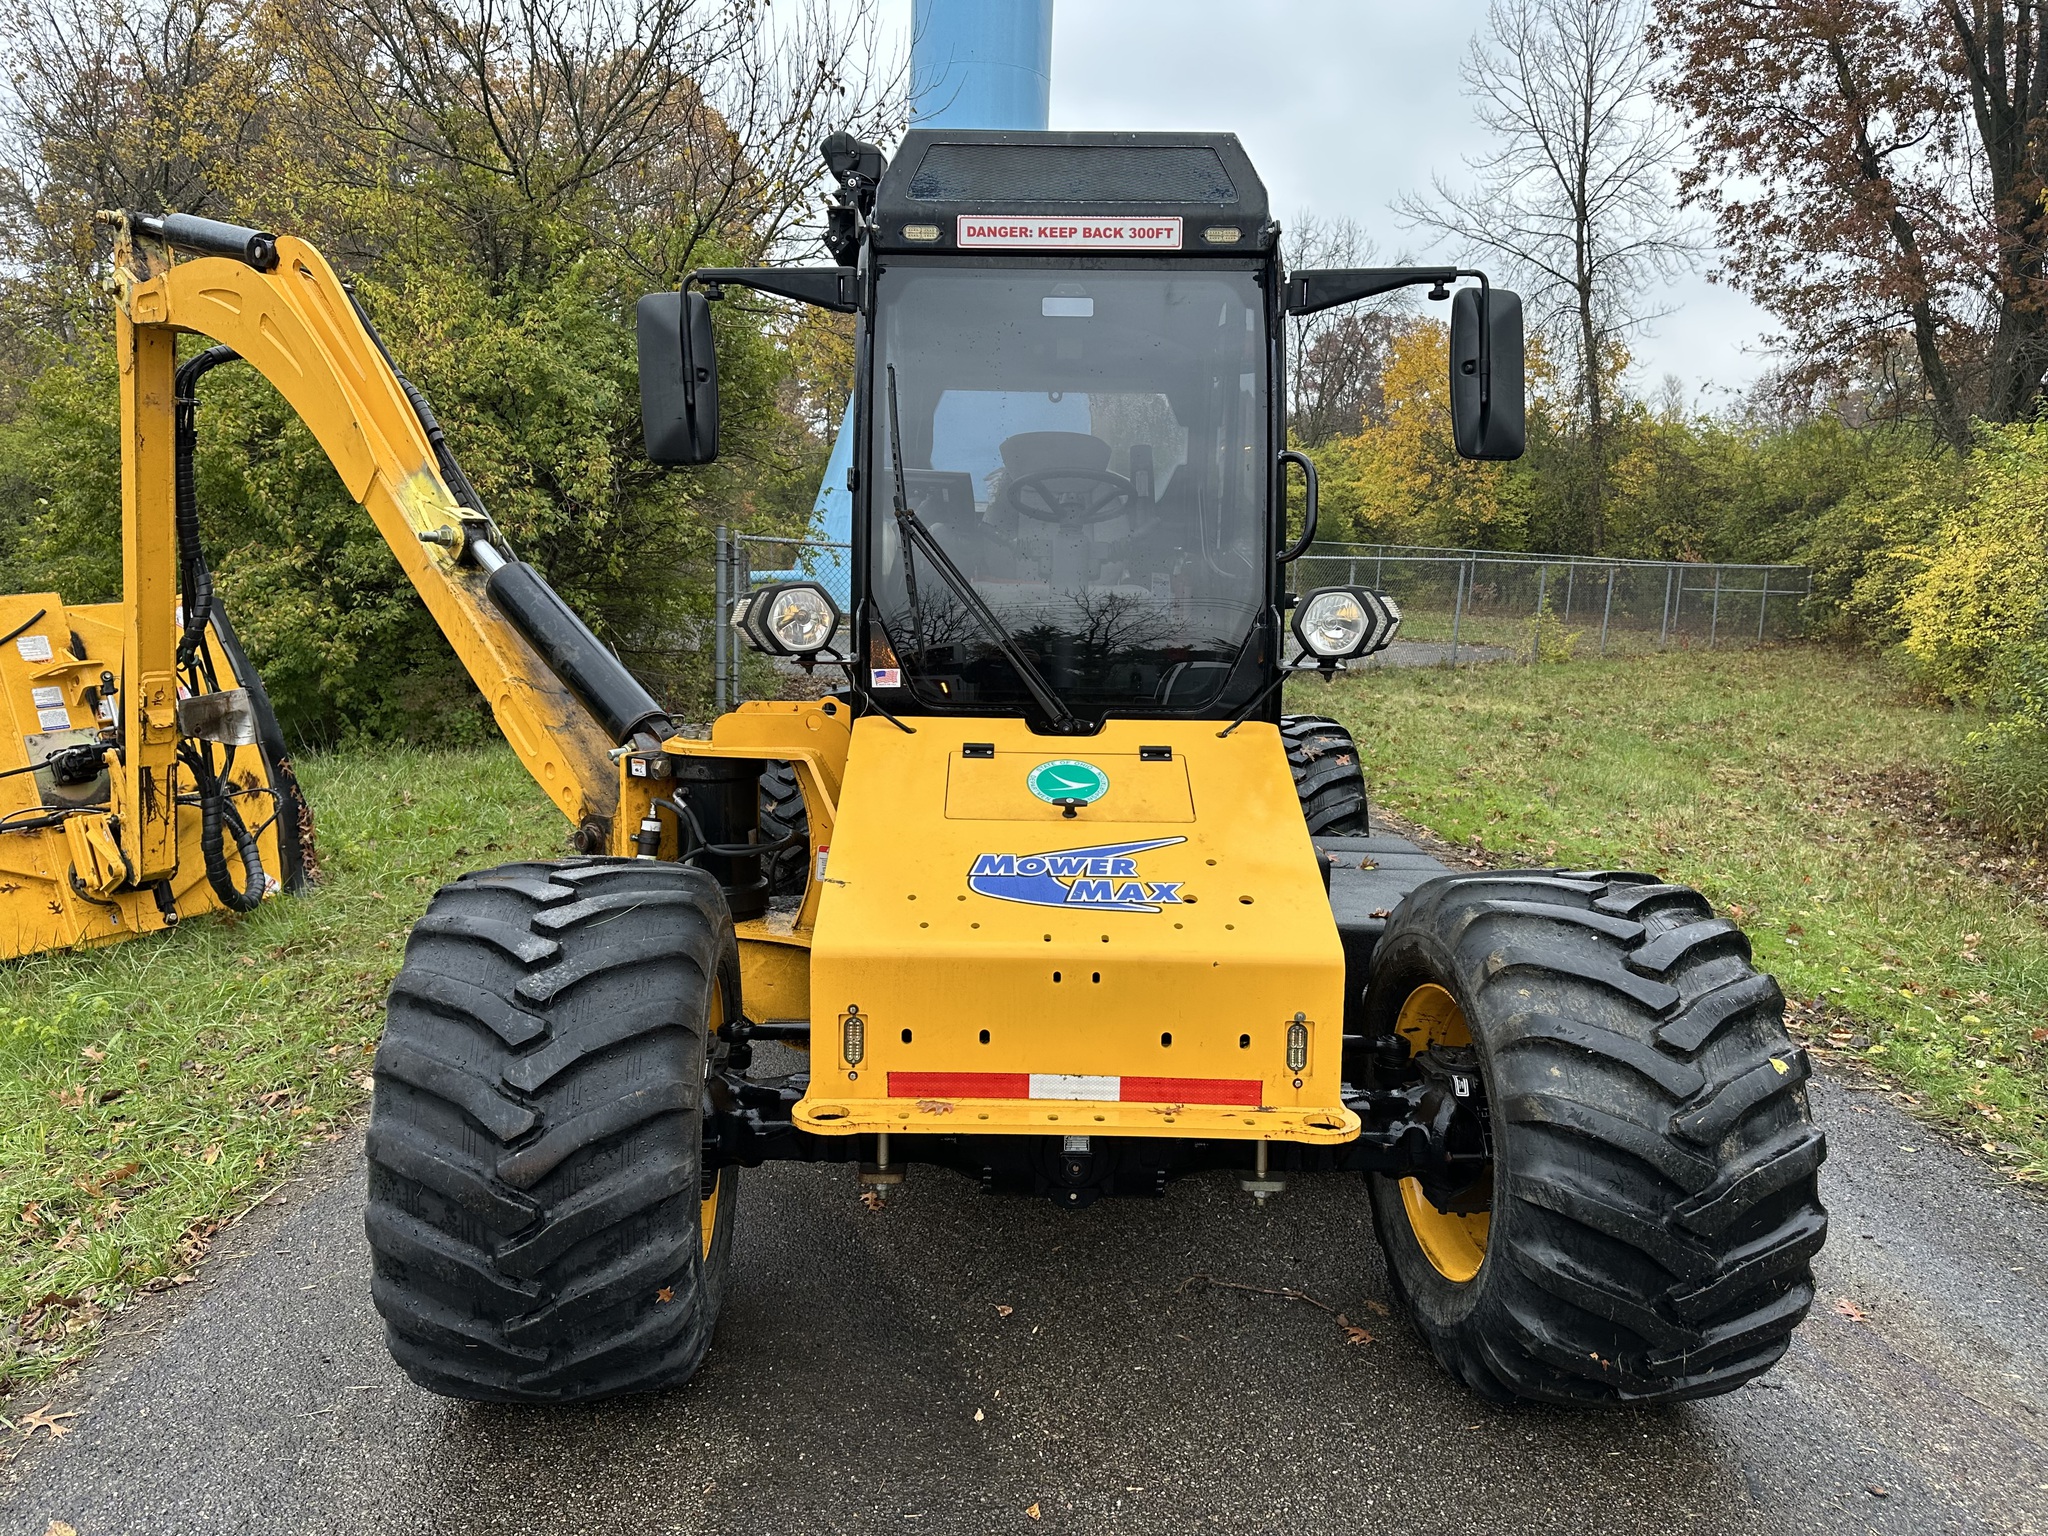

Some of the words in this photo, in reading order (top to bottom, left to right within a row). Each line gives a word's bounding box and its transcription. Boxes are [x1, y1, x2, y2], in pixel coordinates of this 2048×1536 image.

[966, 226, 1033, 238] DANGER:
[1038, 227, 1078, 238] KEEP
[1082, 227, 1124, 239] BACK
[1129, 227, 1174, 239] 300FT
[1036, 761, 1057, 772] STATE
[1073, 761, 1094, 770] OHIO
[1029, 774, 1053, 802] DEPARTMEN
[969, 854, 1139, 877] MOWER
[1065, 879, 1184, 903] MAX
